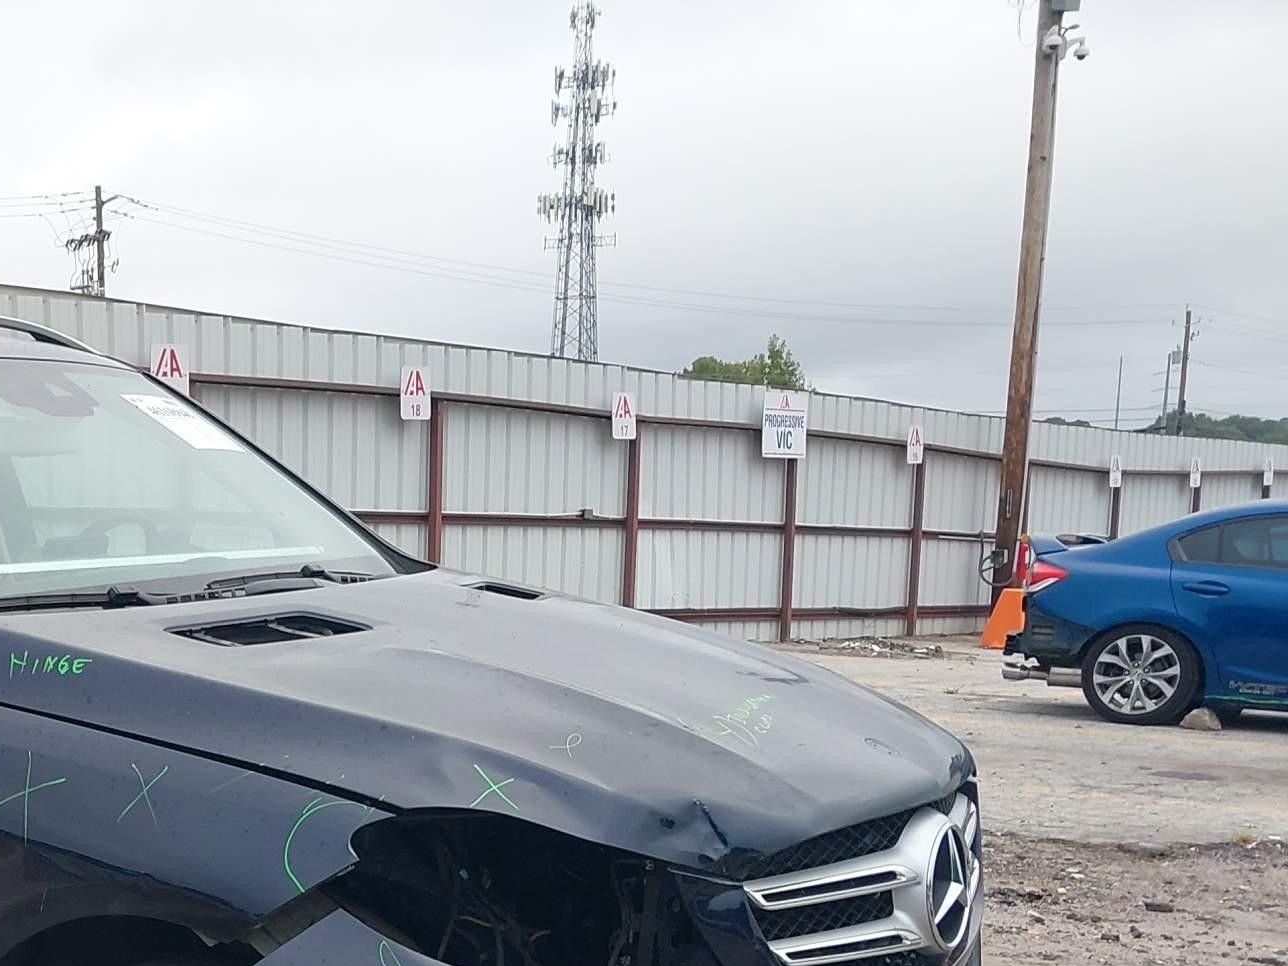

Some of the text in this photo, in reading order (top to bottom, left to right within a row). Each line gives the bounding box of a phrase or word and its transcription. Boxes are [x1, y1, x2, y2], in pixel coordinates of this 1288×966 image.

[411, 403, 421, 417] 18
[764, 413, 805, 429] PROGRESSIVE
[620, 425, 629, 438] 17
[776, 429, 793, 450] VIC
[10, 650, 93, 680] HINGE
